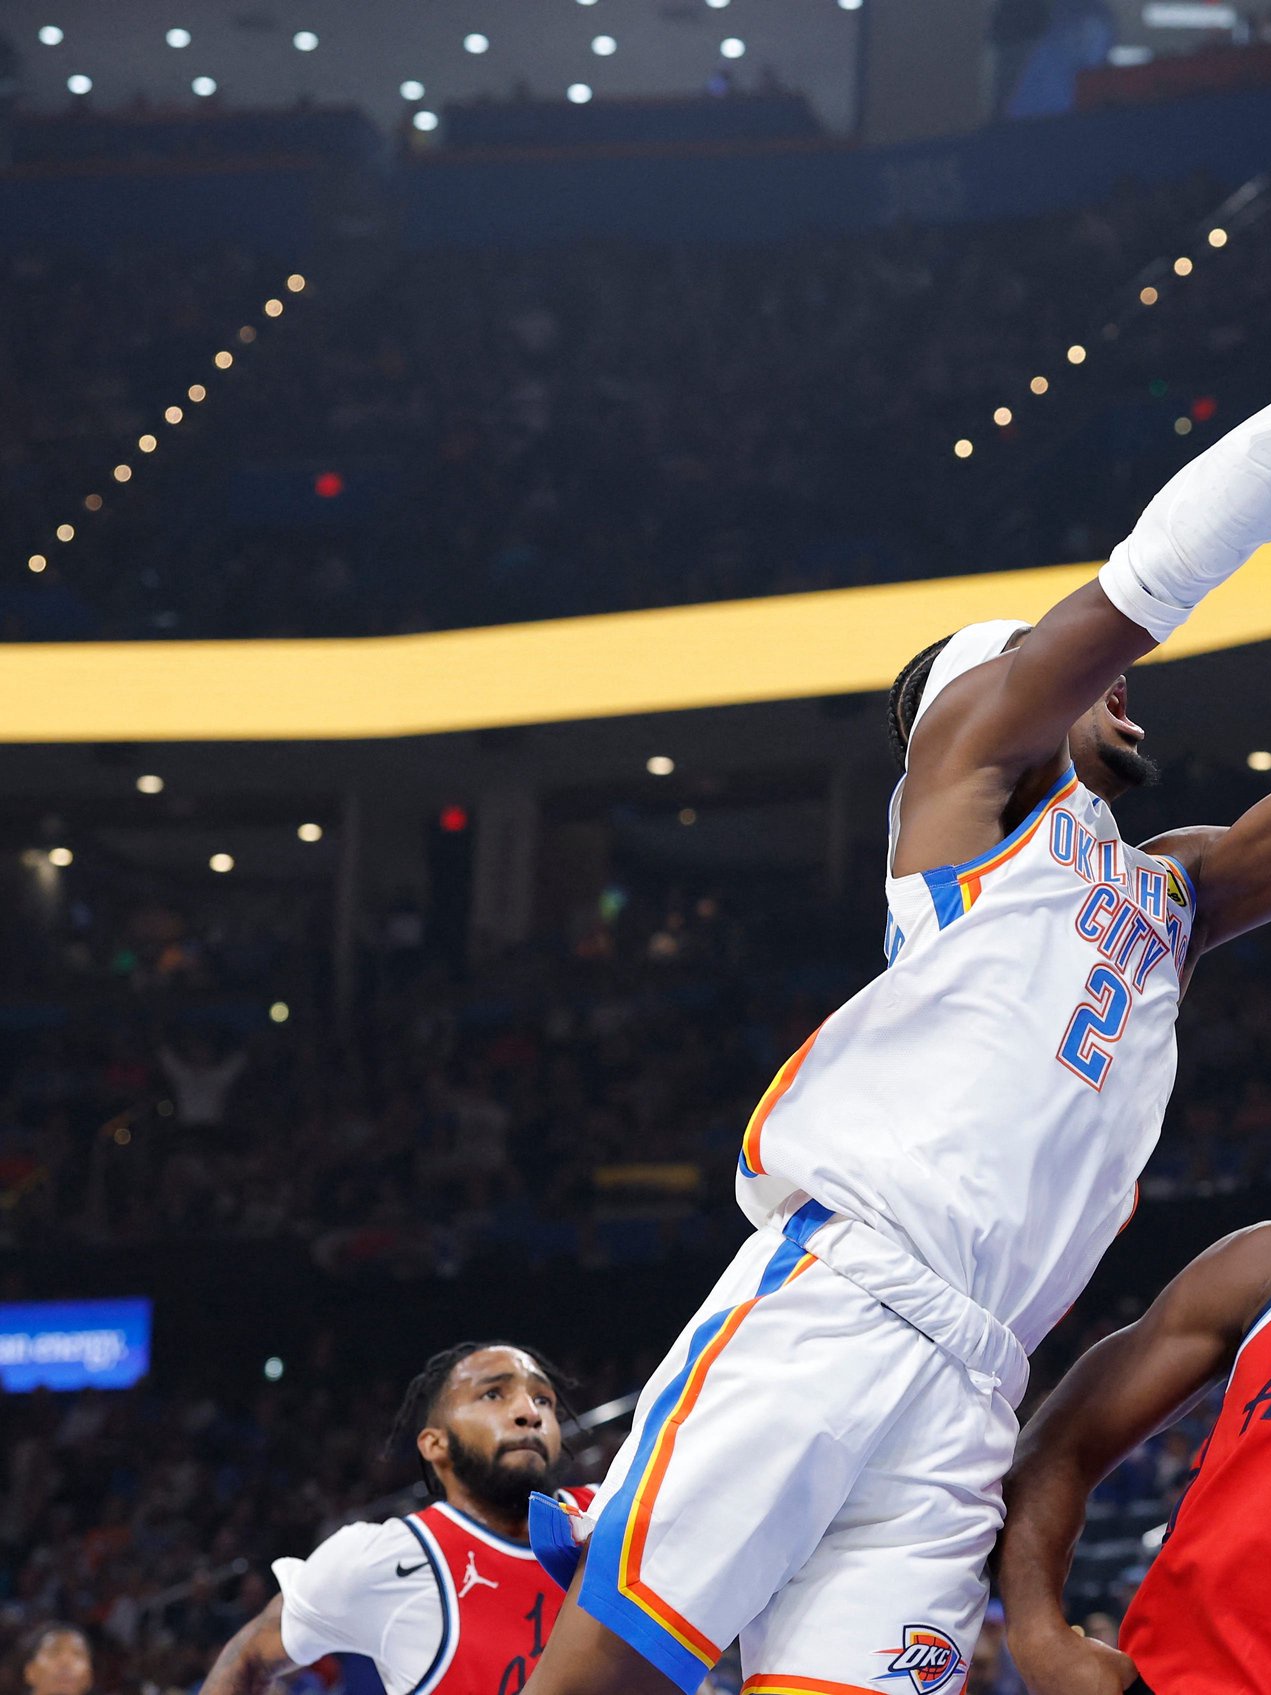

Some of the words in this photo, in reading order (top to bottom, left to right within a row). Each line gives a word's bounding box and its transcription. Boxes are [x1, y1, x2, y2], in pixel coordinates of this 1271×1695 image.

[1075, 882, 1170, 995] CITY
[1056, 962, 1133, 1093] 2
[892, 1643, 951, 1670] OKC
